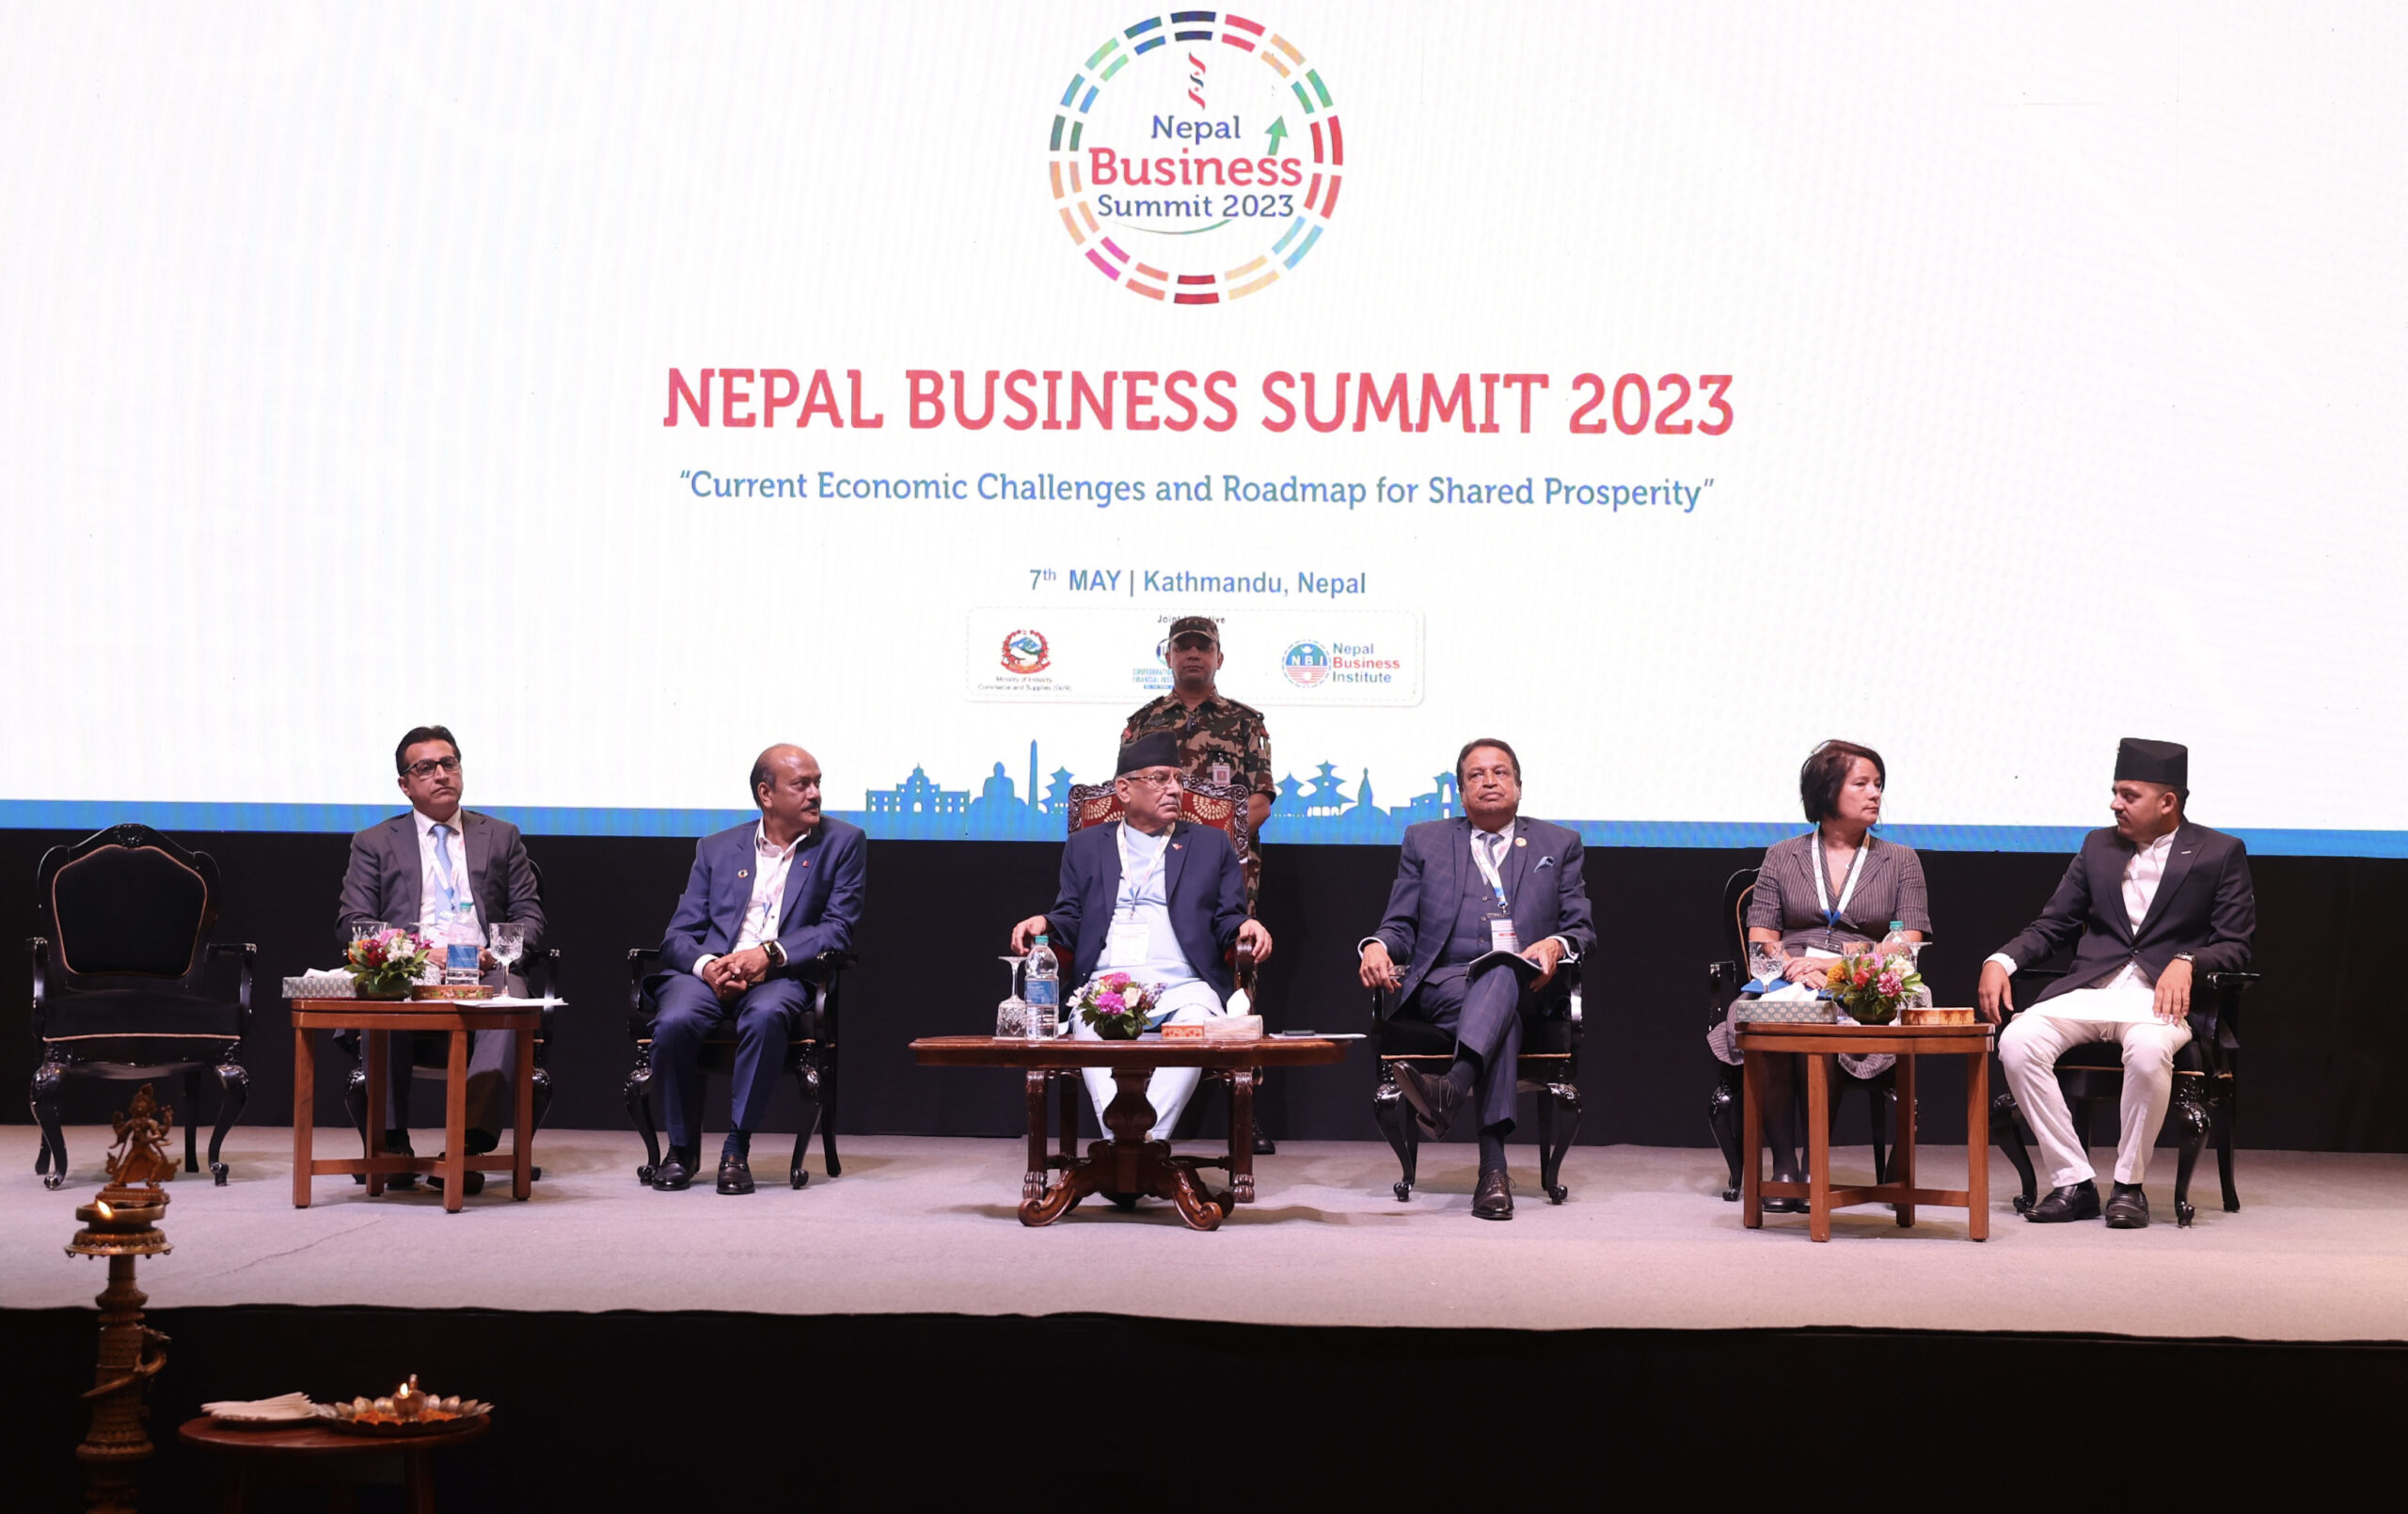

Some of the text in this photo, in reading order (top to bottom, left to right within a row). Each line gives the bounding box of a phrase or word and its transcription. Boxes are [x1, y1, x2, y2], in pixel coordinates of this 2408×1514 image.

[1151, 115, 1242, 146] Nepal
[1088, 147, 1303, 187] Business
[1098, 194, 1294, 218] Summit 2023
[663, 368, 1735, 436] NEPAL BUSINESS SUMMIT 2023
[817, 471, 968, 500] Economic
[977, 472, 1146, 509] Challenges
[1155, 474, 1212, 502] and
[1222, 474, 1367, 511] Roadmap
[1376, 476, 1419, 504] for
[1429, 476, 1535, 505] Shared
[1029, 568, 1056, 591] 7th
[1069, 569, 1122, 591] MAY
[1144, 570, 1289, 595] Kathmandu,
[1298, 571, 1366, 599] Nepal
[1332, 642, 1374, 657] Nepal
[1332, 656, 1401, 670] Business
[1332, 670, 1392, 683] Institute
